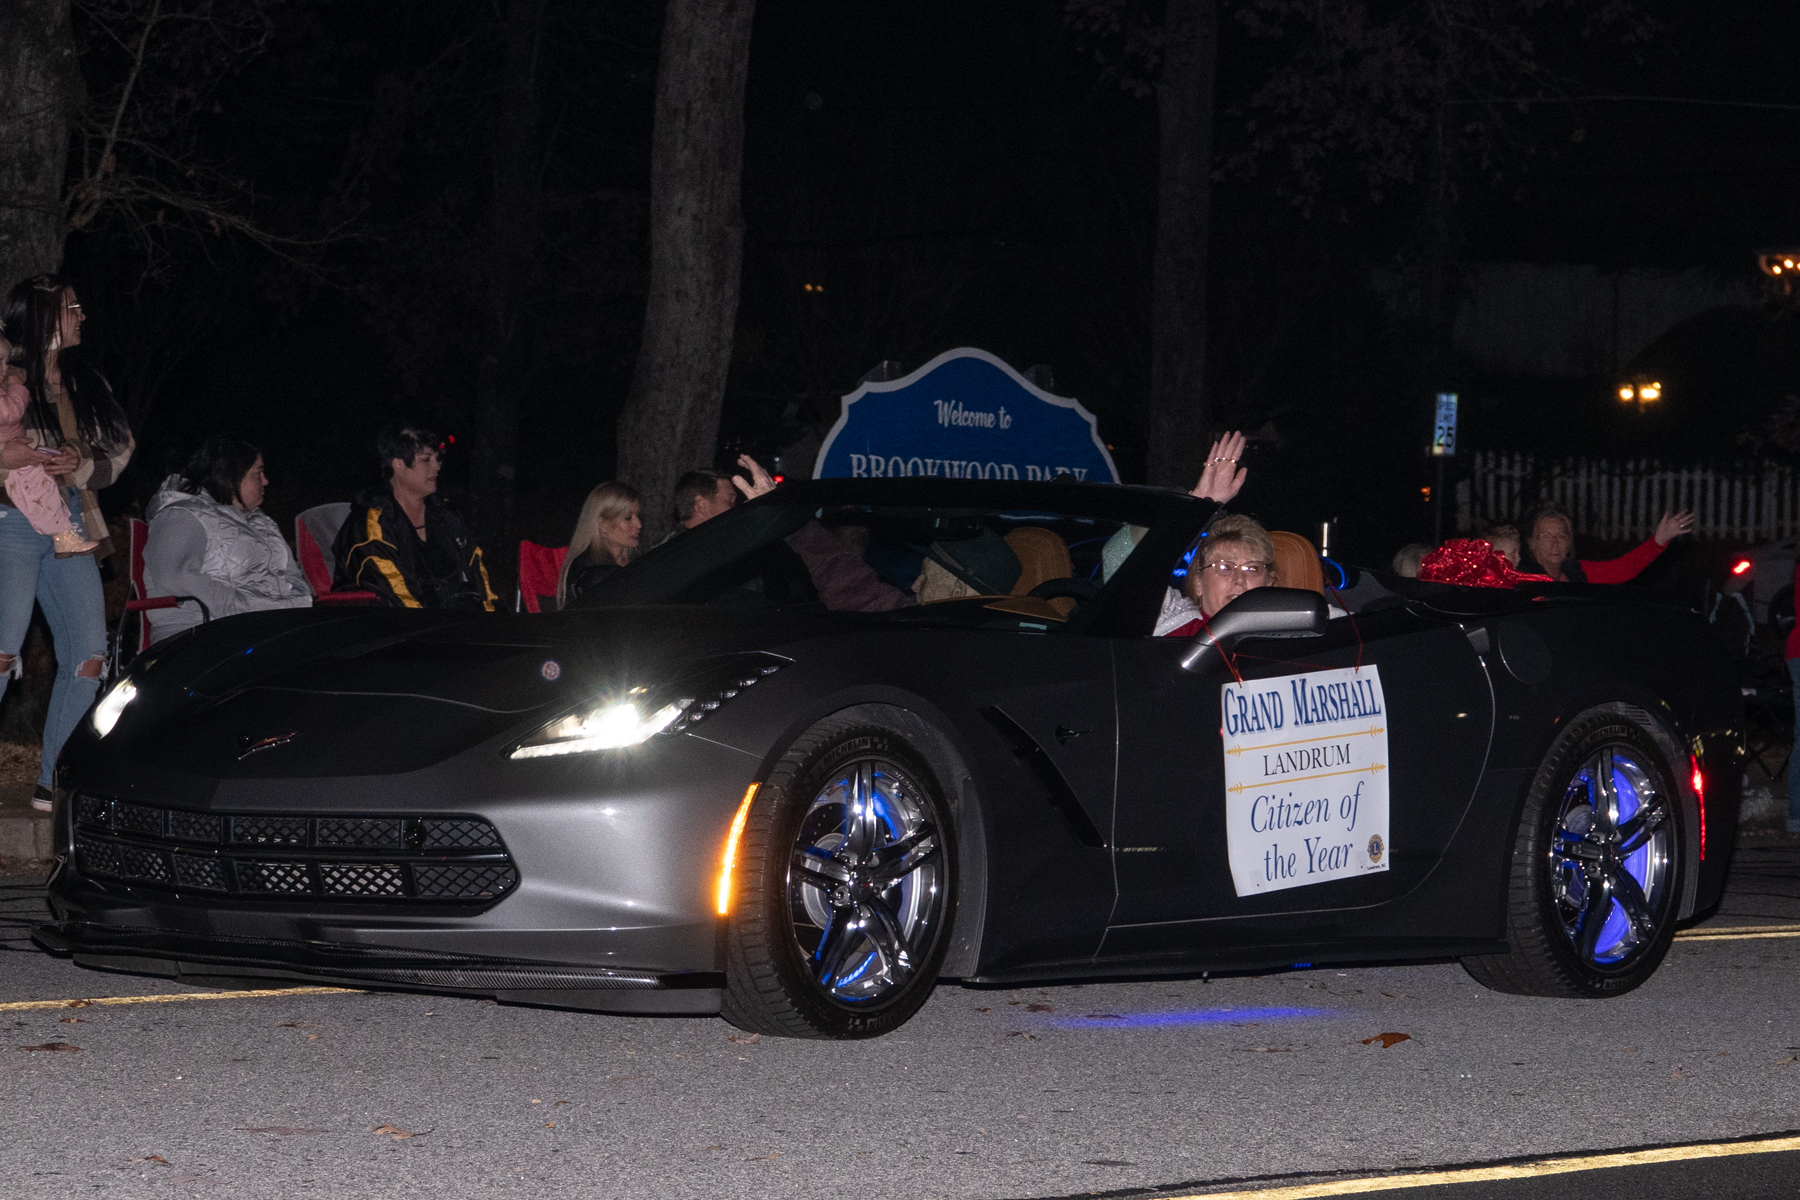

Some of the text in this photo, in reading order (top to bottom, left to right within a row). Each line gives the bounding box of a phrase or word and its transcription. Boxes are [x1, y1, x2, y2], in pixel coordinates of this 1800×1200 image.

[933, 399, 1013, 429] Welcome to
[1437, 426, 1455, 447] 25
[1025, 464, 1088, 482] PA
[1224, 678, 1381, 736] GRAND MARSHALL
[823, 737, 869, 766] MICHELIN
[1263, 743, 1351, 776] LANDRUM
[1251, 780, 1365, 833] Citizen of
[1264, 836, 1354, 882] the Year
